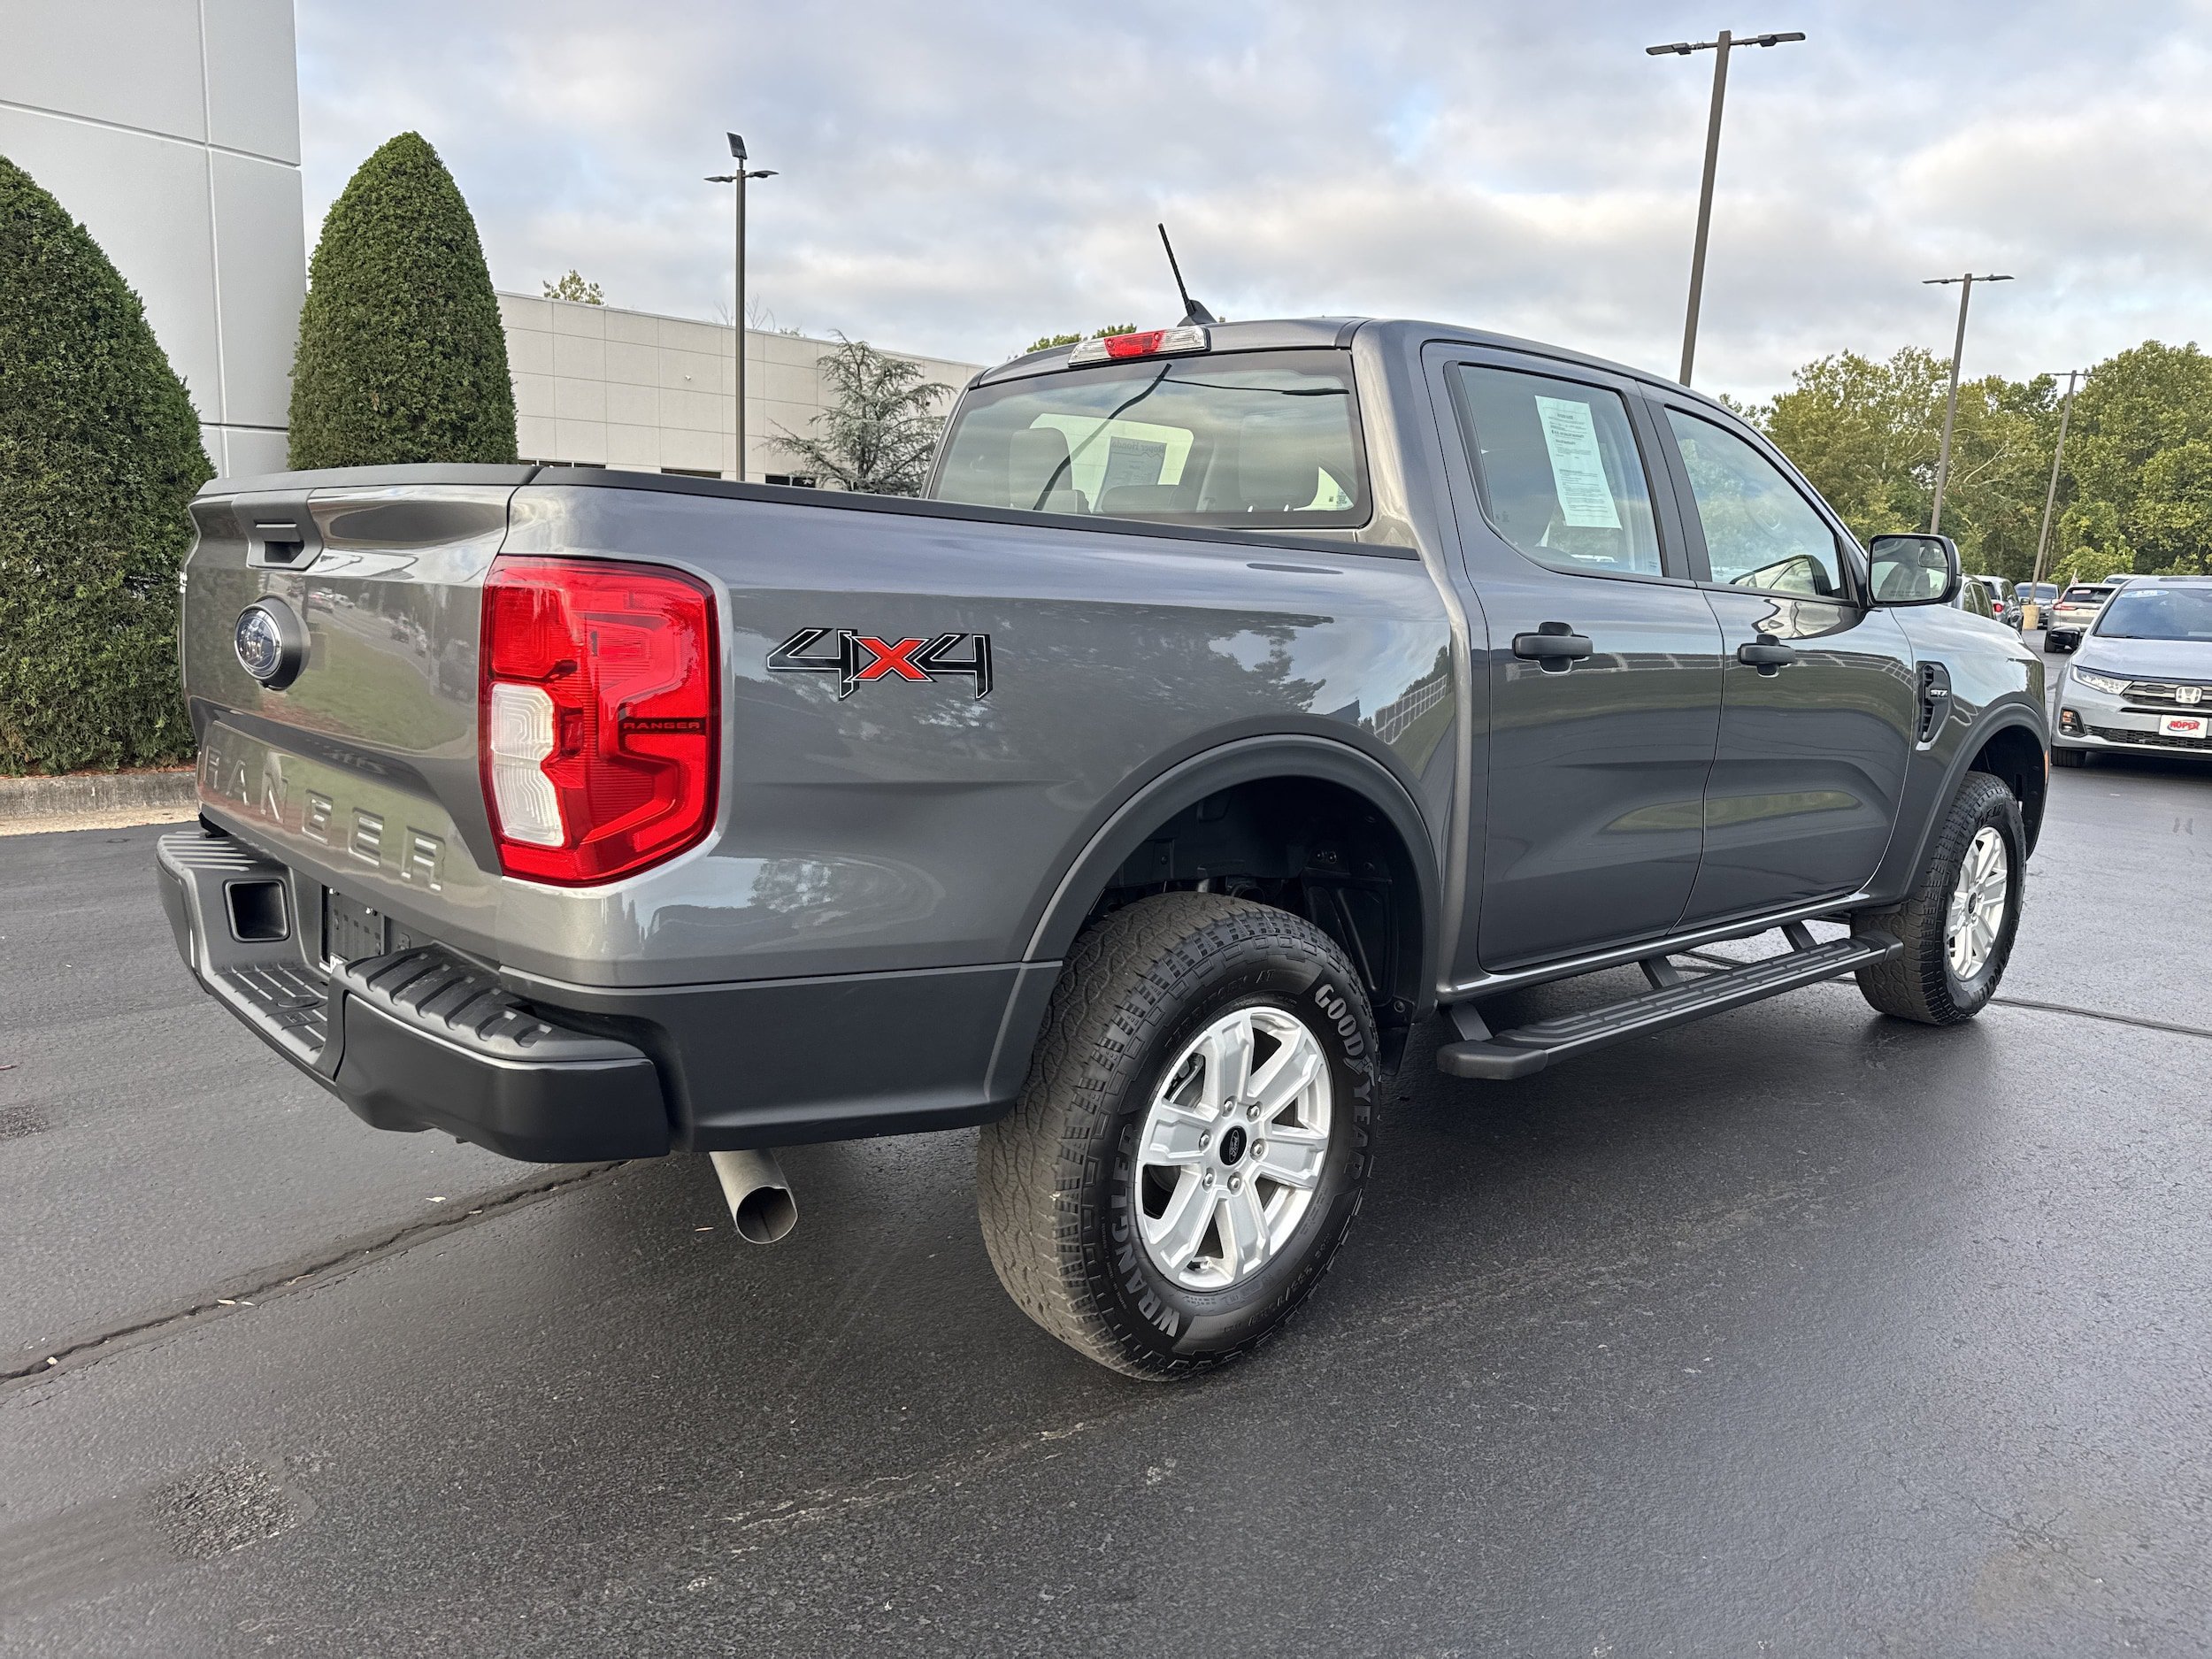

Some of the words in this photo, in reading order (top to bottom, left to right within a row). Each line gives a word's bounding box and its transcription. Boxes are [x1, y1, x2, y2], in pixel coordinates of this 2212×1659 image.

[2170, 720, 2200, 730] ROPER
[204, 745, 445, 890] RANGER
[1315, 983, 1374, 1180] GOODYEAR
[1111, 1124, 1180, 1338] WRANGLER
